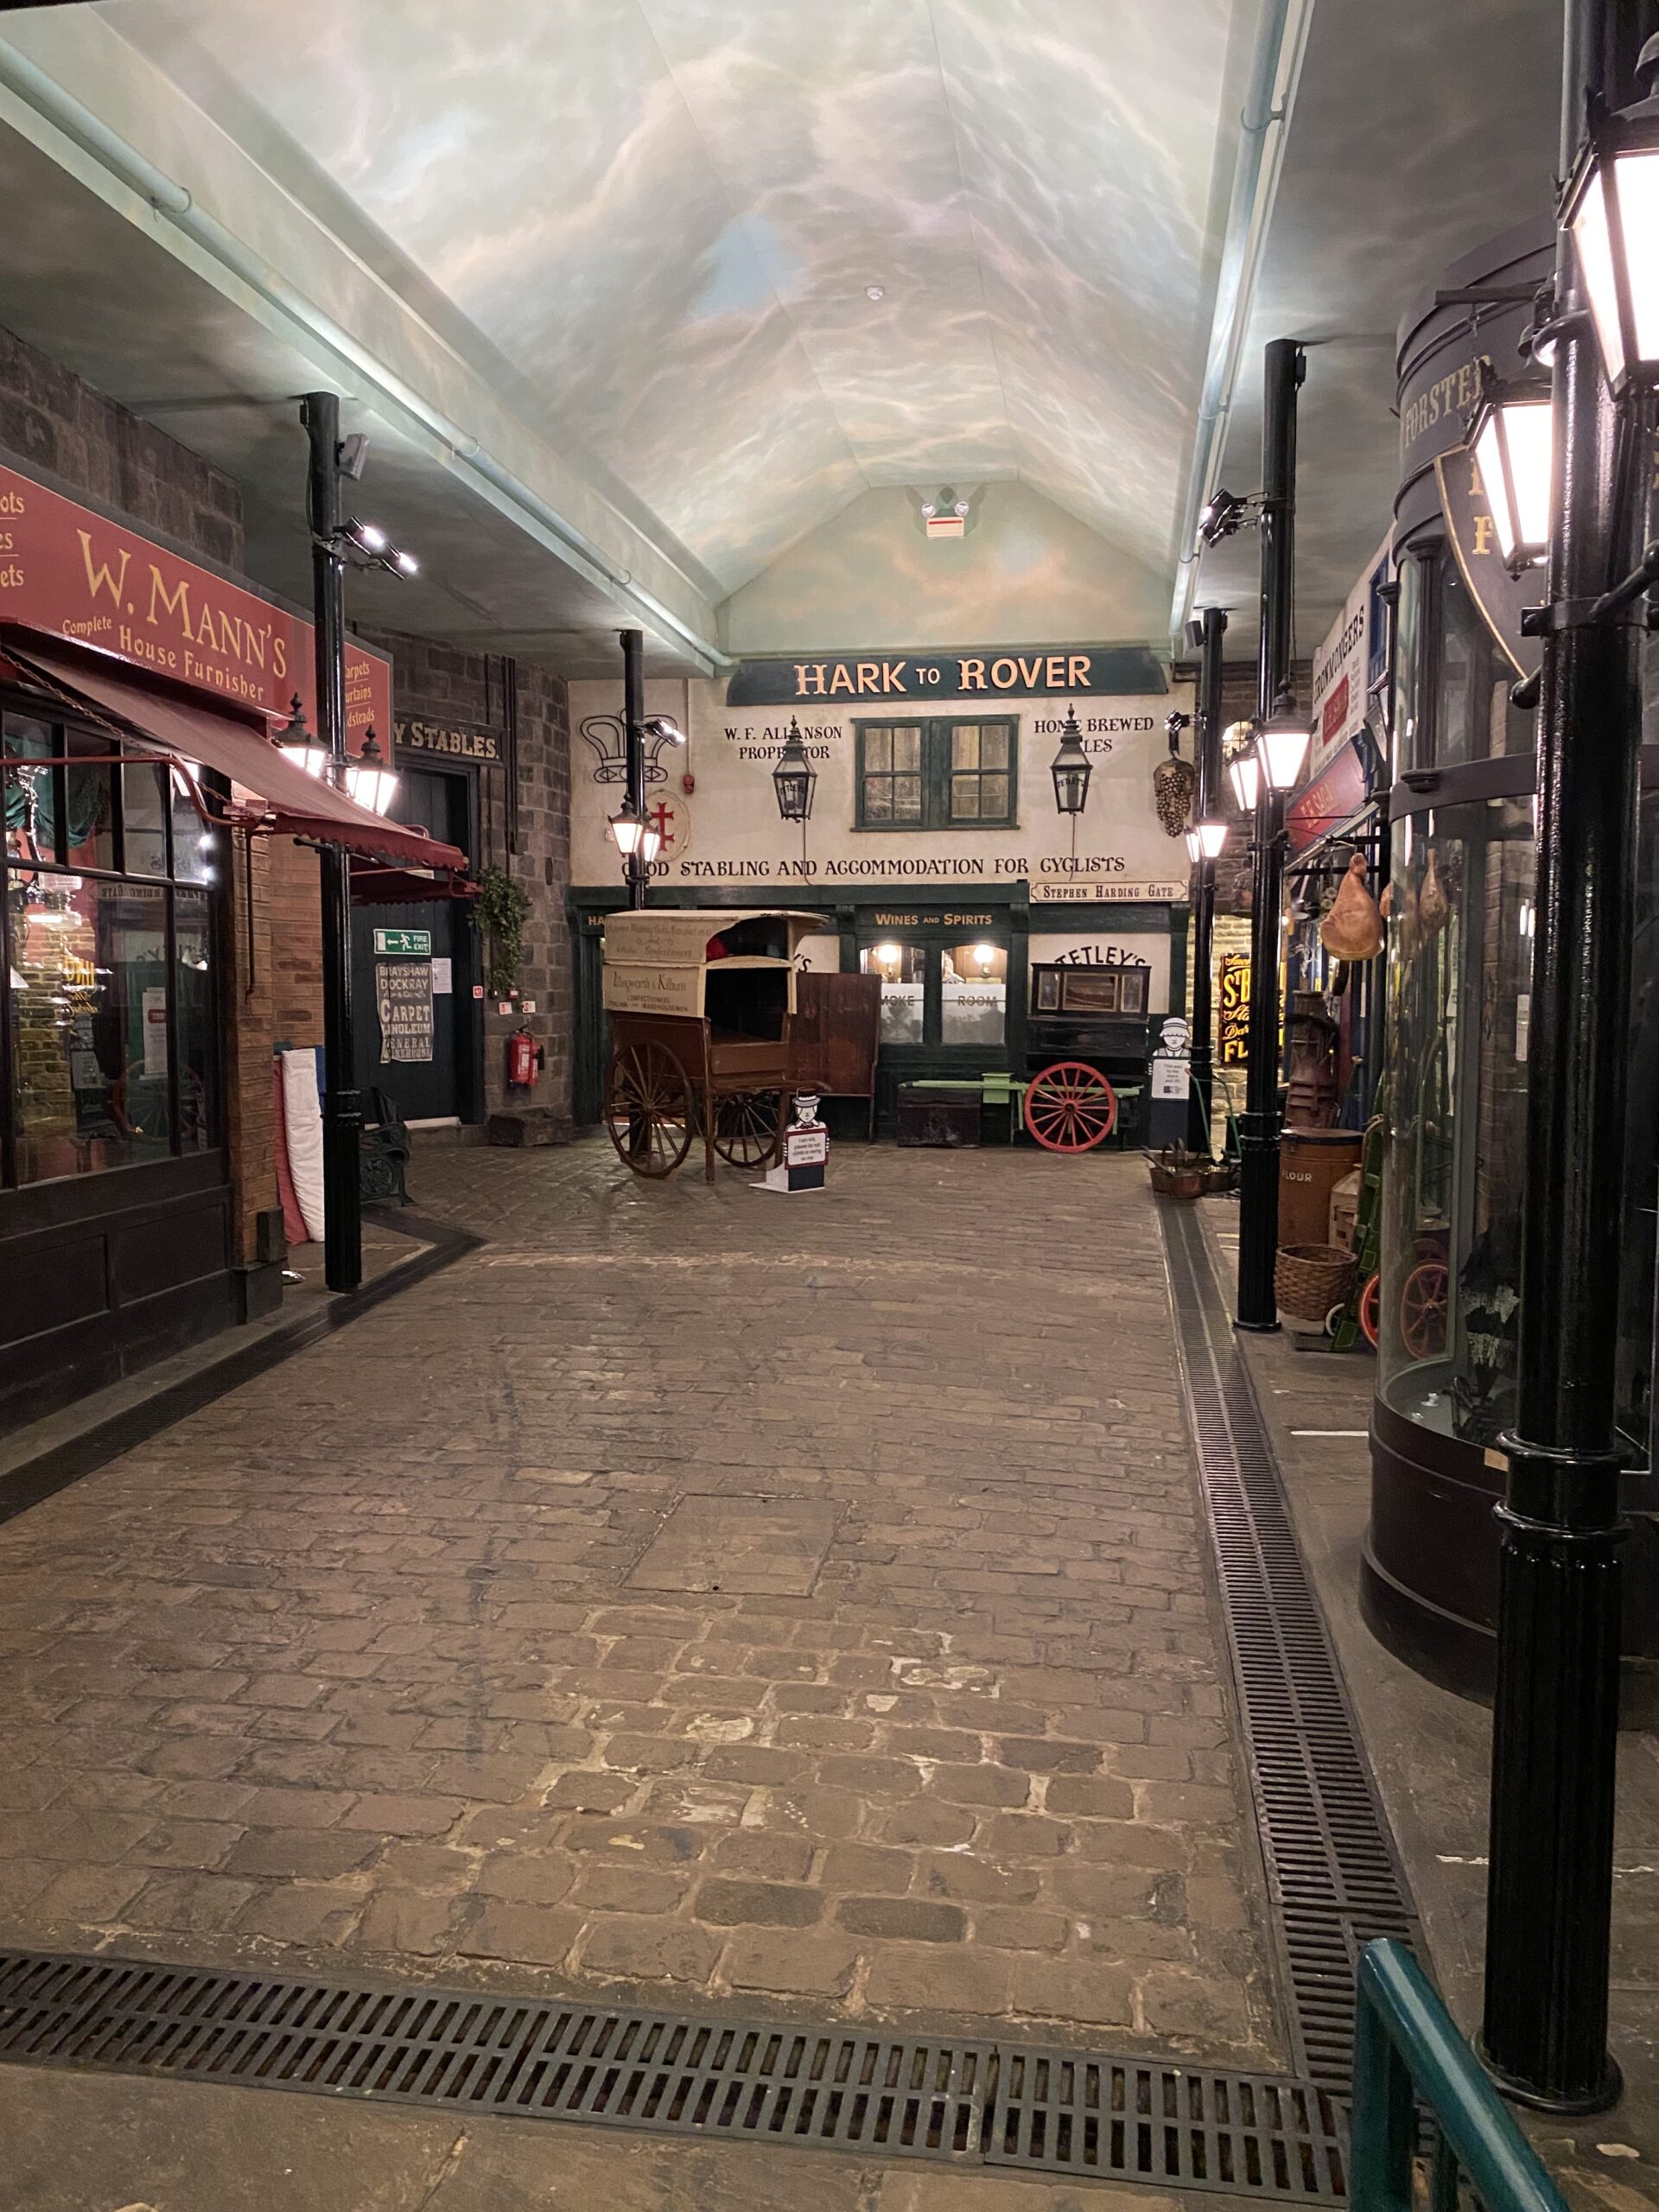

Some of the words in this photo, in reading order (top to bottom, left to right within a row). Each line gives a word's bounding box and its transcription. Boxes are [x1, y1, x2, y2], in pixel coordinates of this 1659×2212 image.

[77, 529, 134, 614] W.
[147, 564, 286, 678] MANN'S
[63, 615, 112, 637] Complete
[119, 625, 176, 668] House
[184, 650, 264, 701] Furnisher
[1314, 605, 1364, 704] IRONMONGERS
[346, 661, 370, 681] arpets
[793, 662, 906, 695] HARK
[916, 668, 941, 684] TO
[957, 655, 1091, 690] ROVER
[346, 685, 372, 702] urtains
[347, 707, 375, 728] dsteads
[1087, 716, 1154, 732] BREWED
[411, 721, 499, 760] STABLES.
[724, 728, 741, 741] W.
[745, 728, 756, 740] F.
[1084, 739, 1113, 753] LES
[680, 861, 770, 876] STABLING
[778, 860, 817, 876] AND
[825, 859, 983, 875] ACCOMMODATION
[995, 858, 1029, 874] FOR
[1040, 856, 1125, 873] CYCLISTS
[1044, 885, 1087, 898] STEPHEN
[1096, 885, 1140, 898] HARDING
[1148, 884, 1173, 897] GATE
[588, 916, 605, 925] HA
[875, 913, 918, 925] WINES
[944, 913, 993, 925] SPIRITS
[379, 966, 429, 976] BRAYSHAW
[381, 978, 429, 989] DOCKRAY
[958, 995, 997, 1007] ROOM
[380, 999, 430, 1022] CARPET
[382, 1023, 430, 1035] LINOLEUM
